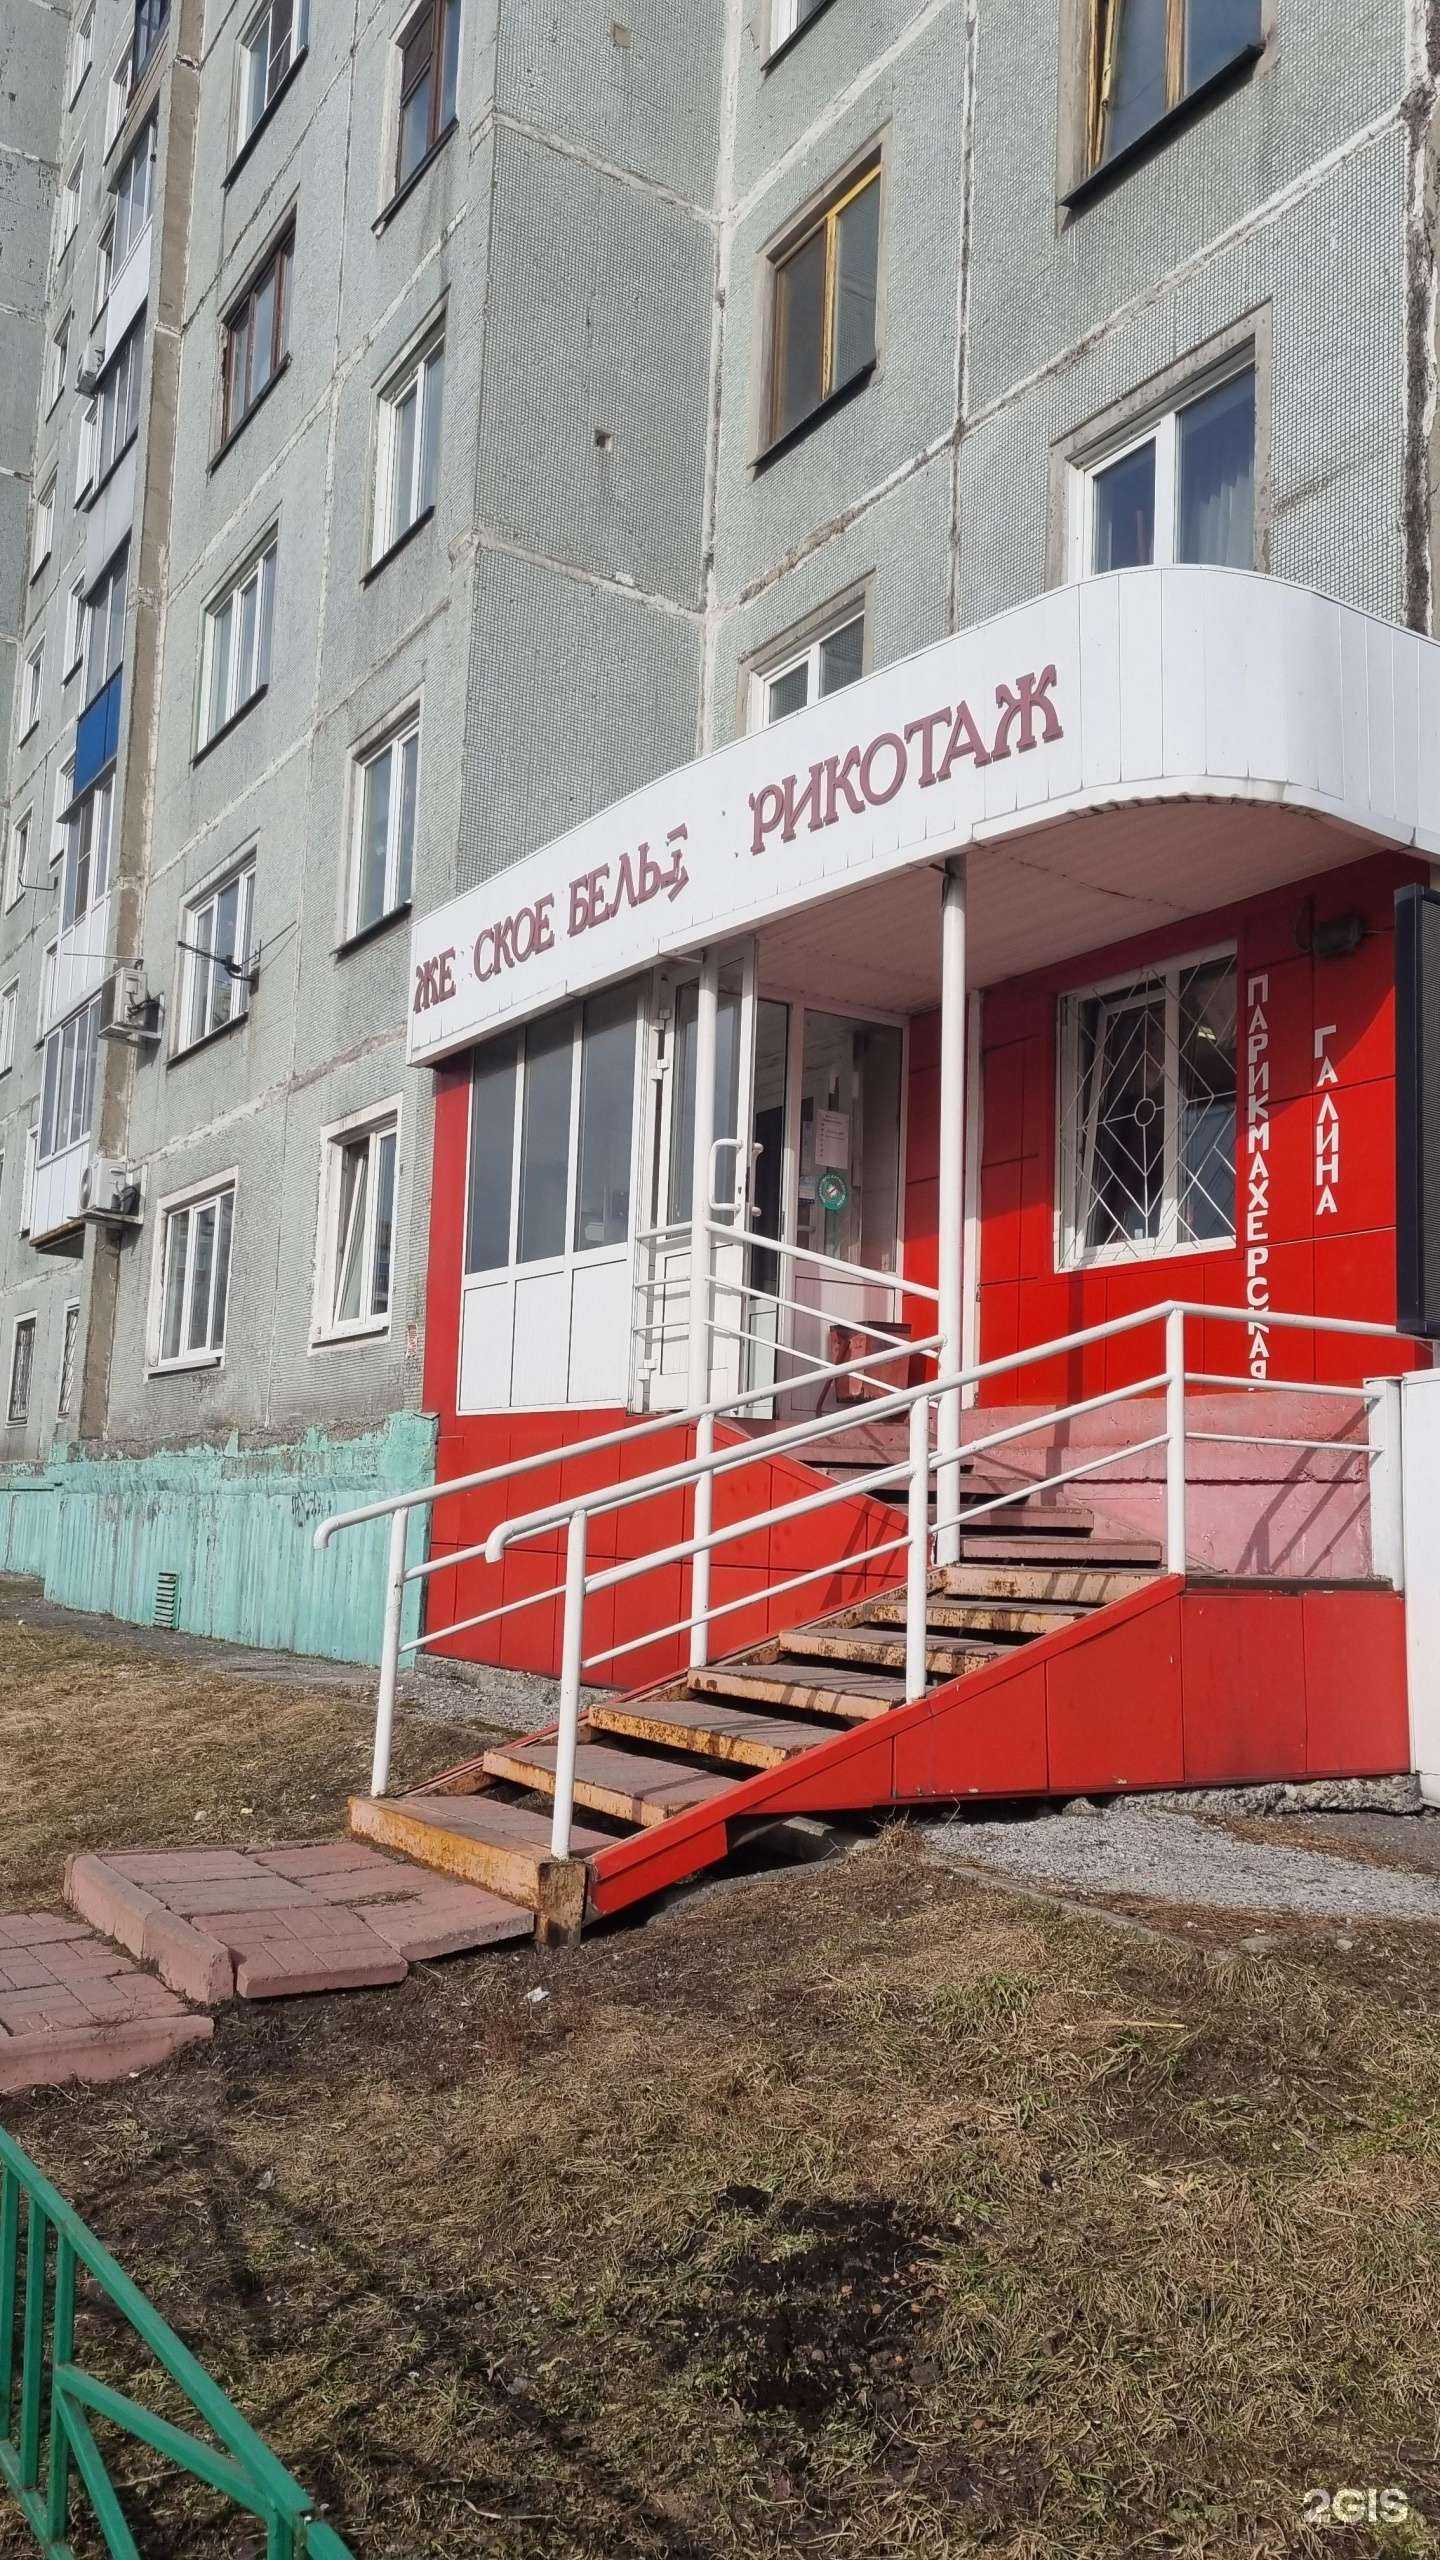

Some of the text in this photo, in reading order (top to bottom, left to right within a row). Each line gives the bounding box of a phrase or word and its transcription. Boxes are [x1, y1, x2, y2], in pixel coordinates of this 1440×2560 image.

[413, 893, 555, 1014] ЖЕСКОЕ
[747, 663, 1064, 856] РИКОТАЖ
[1314, 1024, 1339, 1216] ГАЛИНА
